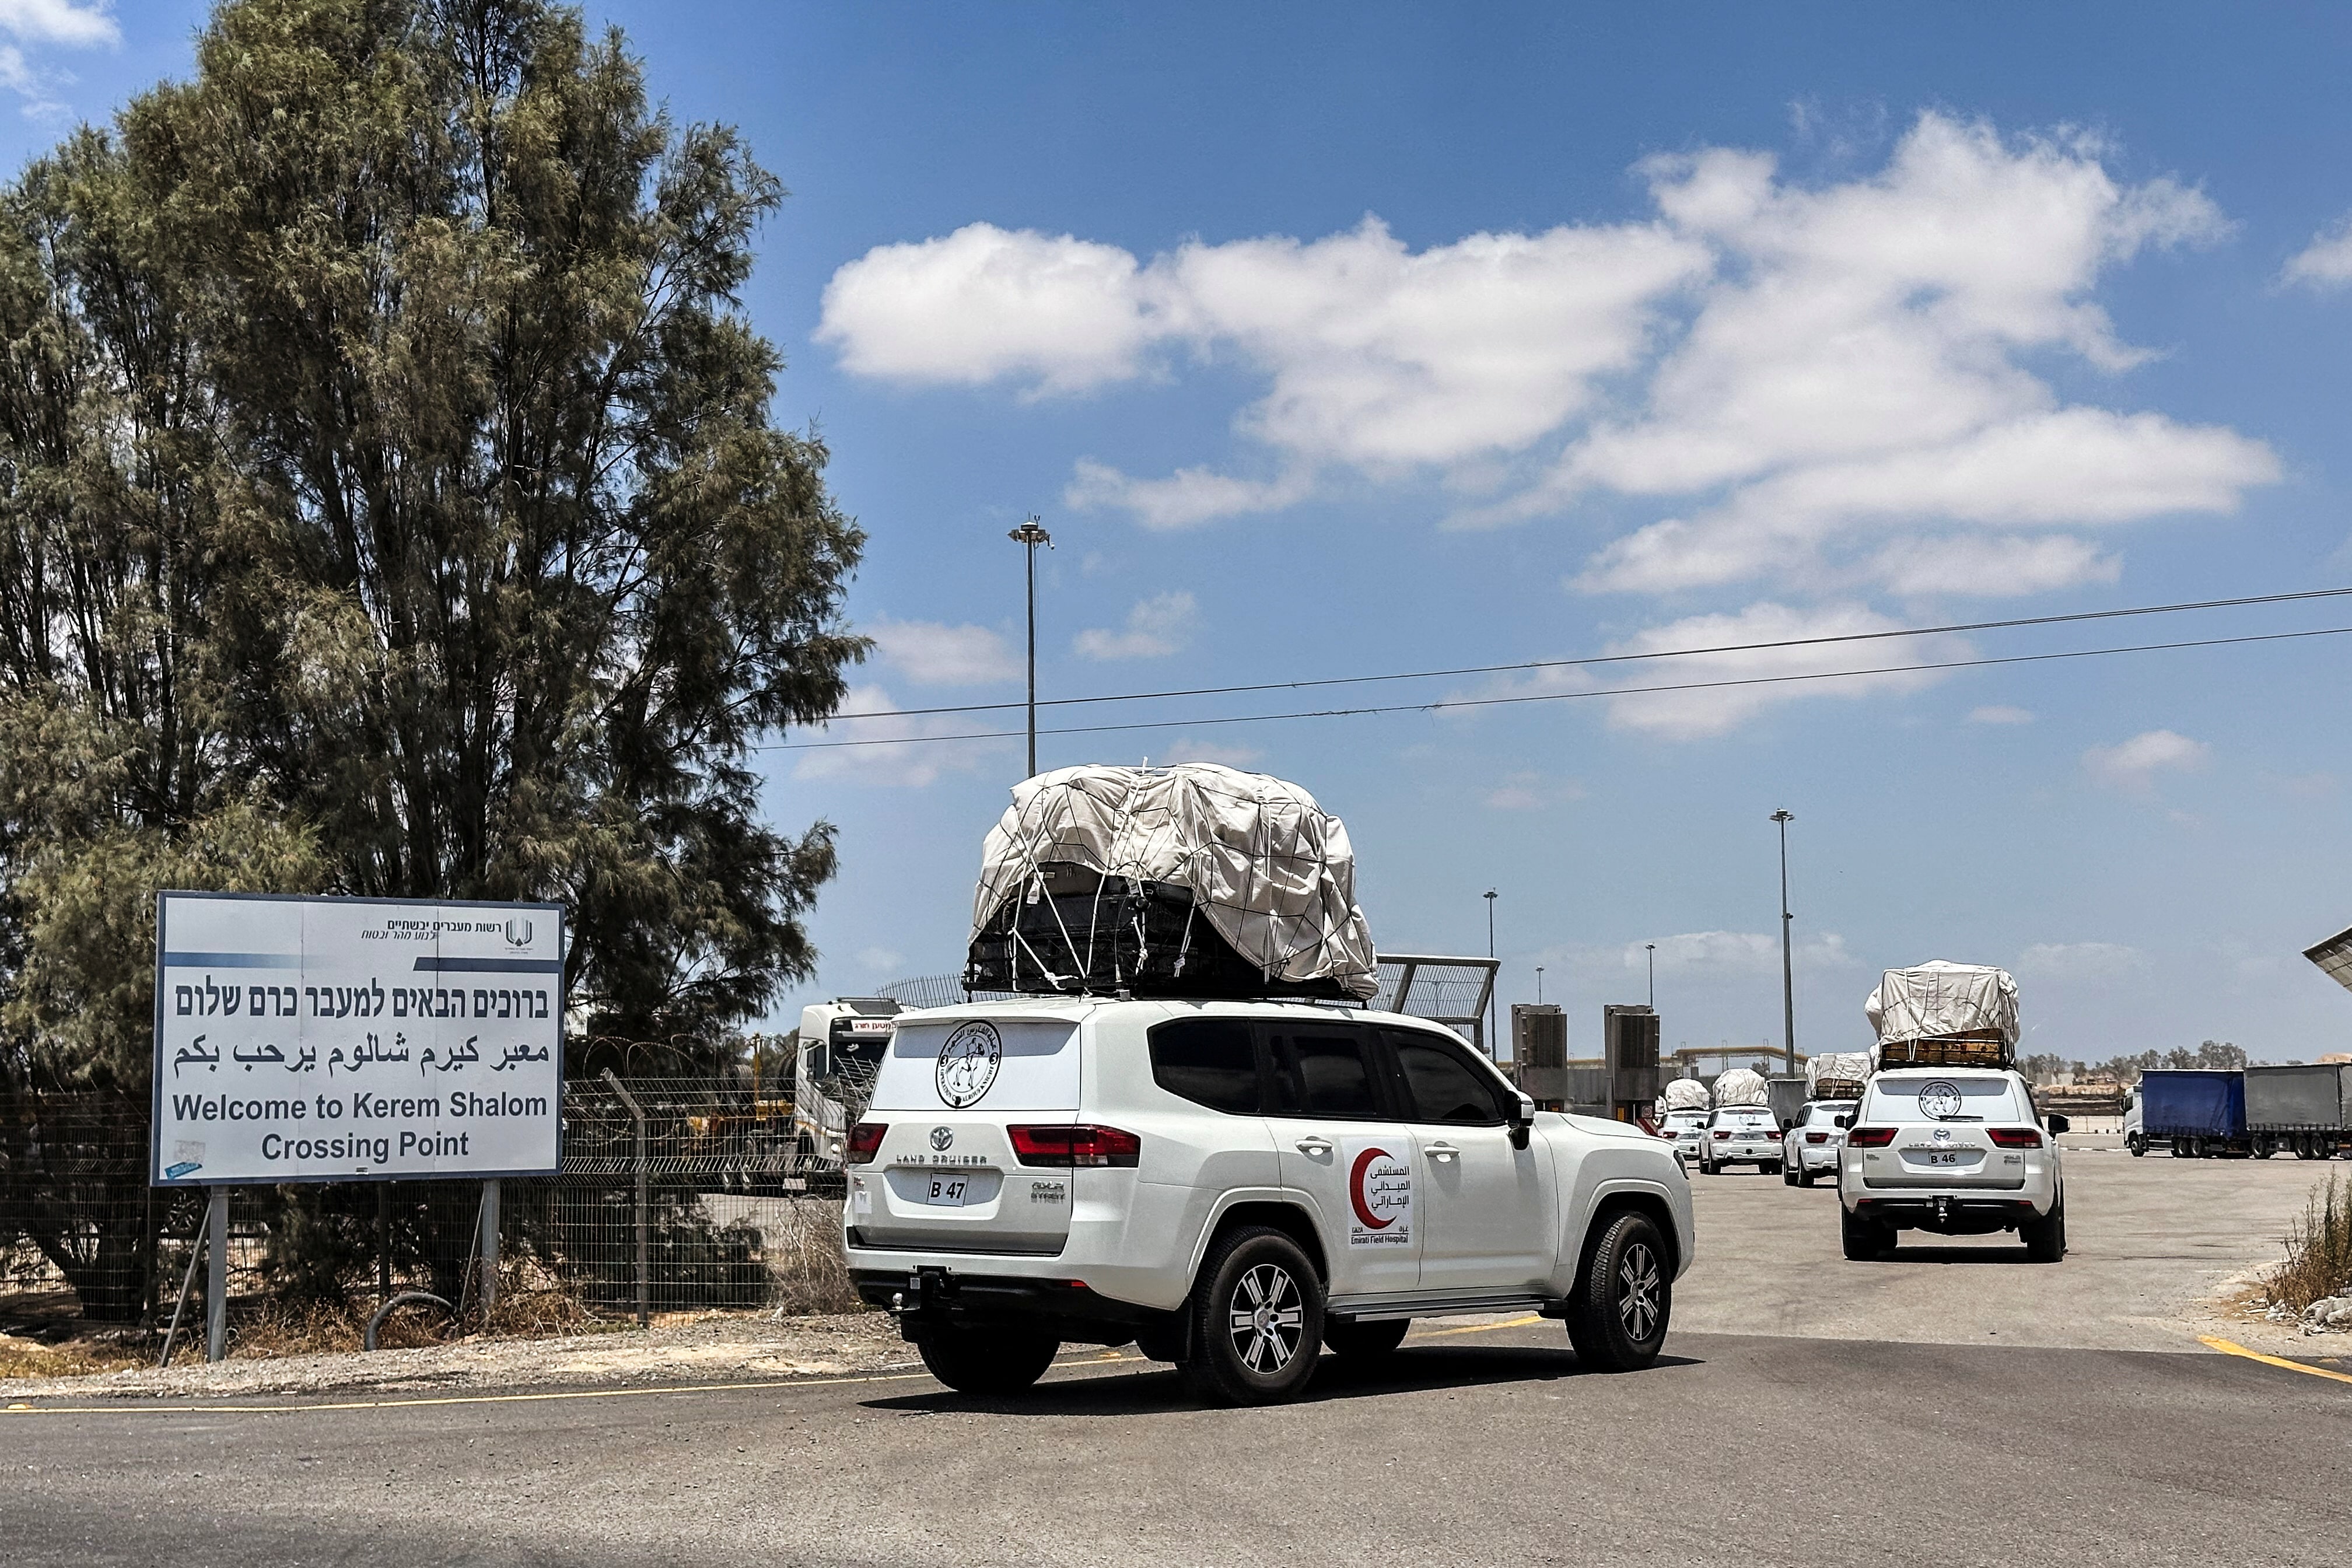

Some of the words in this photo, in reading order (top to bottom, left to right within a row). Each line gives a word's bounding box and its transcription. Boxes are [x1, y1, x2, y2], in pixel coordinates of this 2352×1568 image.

[361, 930, 388, 939] ובטוח
[387, 921, 429, 930] יבשתיים
[393, 931, 411, 940] מהר
[433, 922, 471, 932] מעברים
[475, 923, 502, 933] רשות
[176, 975, 241, 1016] שלום
[249, 986, 297, 1016] כרם
[305, 977, 385, 1019] למעבר
[393, 988, 465, 1017] הבאים
[474, 989, 548, 1018] ברוכים
[174, 1034, 220, 1079] بكم
[233, 1045, 316, 1072] يرحب
[328, 1031, 409, 1078] شالوم
[421, 1035, 479, 1077] كيرم
[490, 1044, 549, 1071] معبر
[173, 1094, 306, 1121] Welcome
[316, 1094, 343, 1119] to
[353, 1093, 440, 1118] Kerem
[450, 1091, 547, 1117] Shalom
[262, 1133, 389, 1164] Crossing
[400, 1131, 469, 1156] Point
[1930, 1155, 1938, 1164] B
[1941, 1154, 1956, 1163] 46
[1370, 1165, 1410, 1179] المستشفى
[930, 1181, 942, 1198] B
[946, 1182, 965, 1199] 47
[1370, 1180, 1410, 1196] الميداني
[1371, 1195, 1409, 1211] الإماراتي
[1351, 1236, 1369, 1245] Emirati
[1370, 1236, 1384, 1244] Field
[1385, 1234, 1408, 1244] Hospital
